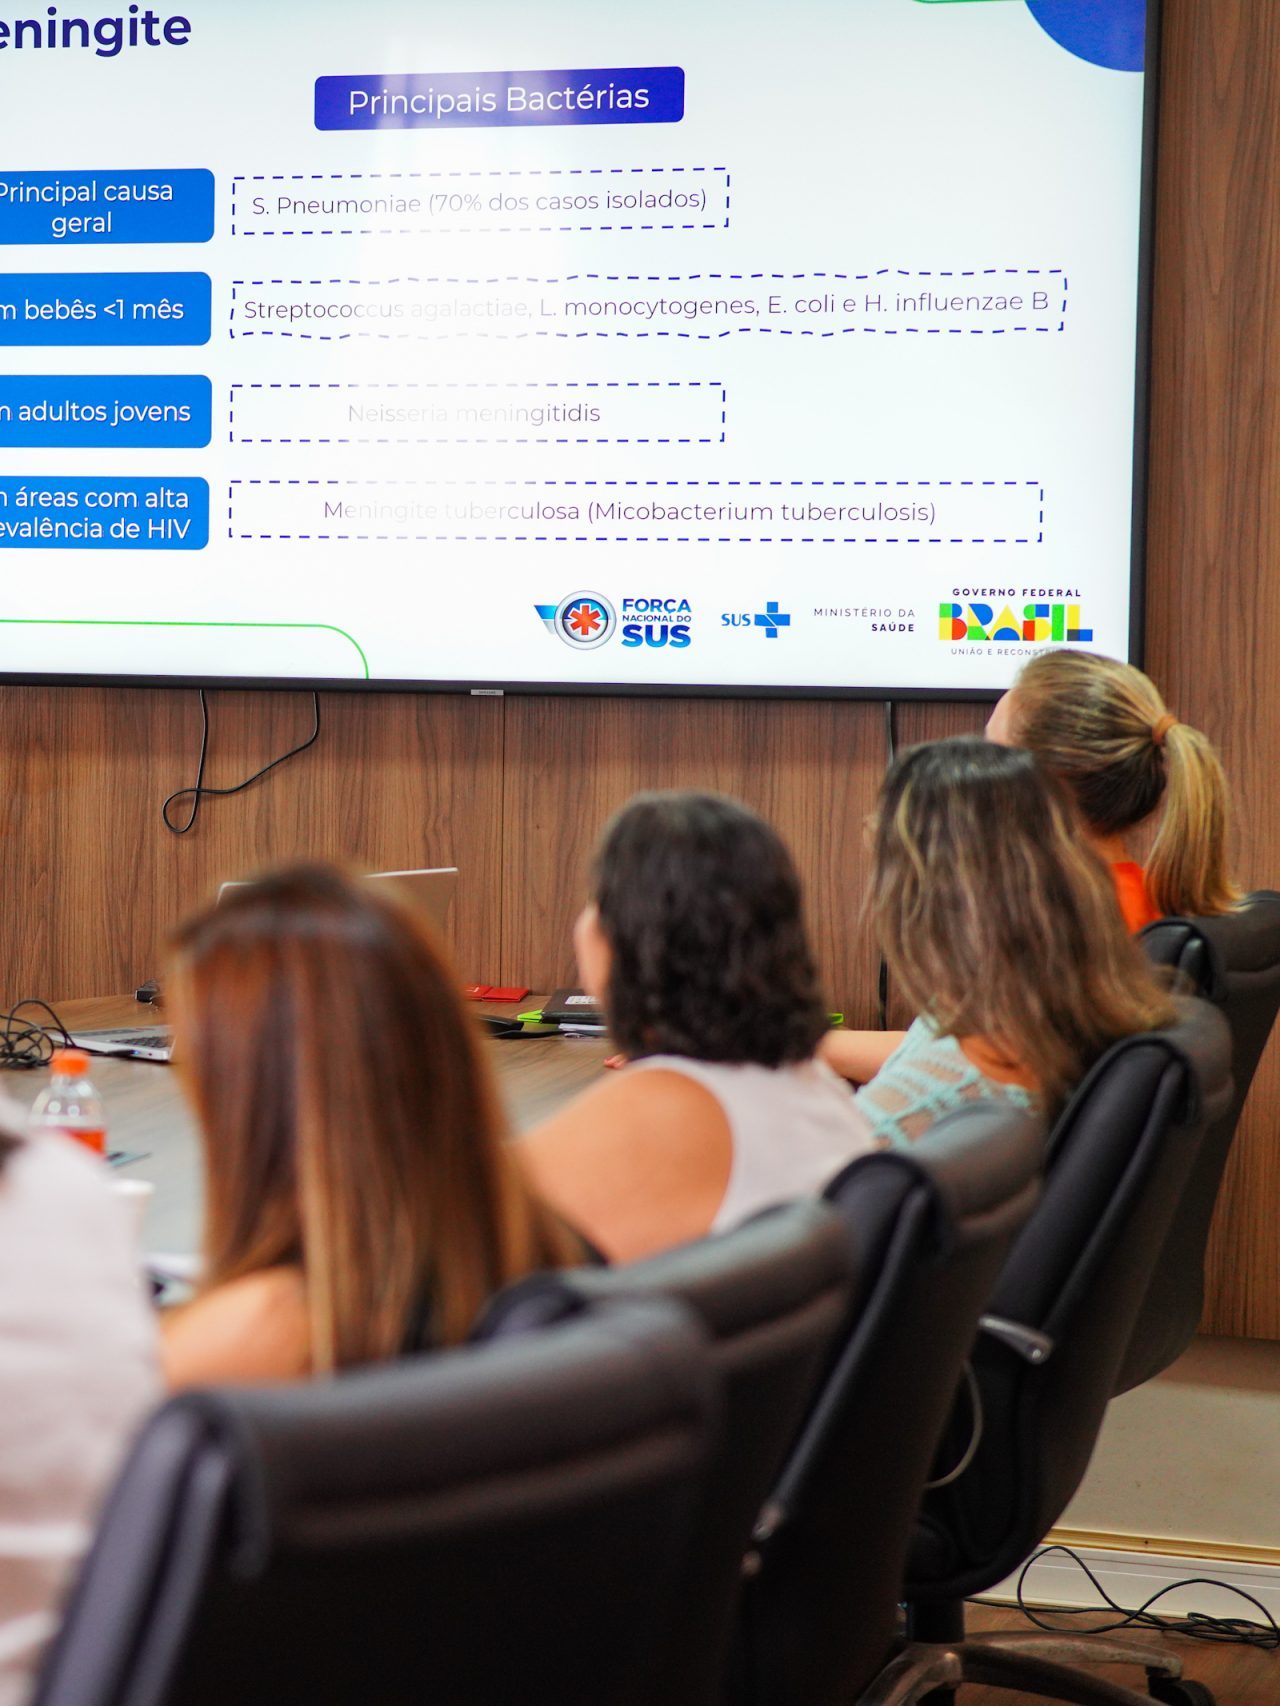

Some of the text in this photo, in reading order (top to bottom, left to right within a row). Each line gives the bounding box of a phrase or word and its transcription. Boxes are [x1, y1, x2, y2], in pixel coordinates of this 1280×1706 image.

[349, 82, 650, 120] Principais Bactérias
[103, 184, 173, 202] causa
[252, 188, 706, 217] S. Pneumoniae (70% dos casos isolados)
[51, 212, 113, 238] geral
[24, 298, 97, 321] bebês
[132, 297, 184, 320] mês
[243, 300, 406, 325] Streptococcus
[539, 301, 558, 318] L.
[564, 298, 761, 321] monocytogenes,
[768, 295, 787, 314] E.
[794, 293, 835, 314] coli
[842, 298, 857, 313] e
[865, 293, 888, 313] H.
[896, 292, 1024, 312] influenzae
[1032, 291, 1049, 310] B
[18, 399, 107, 422] adultos
[113, 401, 191, 427] jovens
[348, 402, 601, 427] Neisseria meningitidis
[15, 485, 79, 508] áreas
[84, 491, 138, 508] com
[144, 487, 189, 508] alta
[324, 500, 936, 526] Meningite tuberculosa (Micobacterium tuberculosis)
[109, 518, 140, 539] de
[148, 518, 192, 539] HIV
[952, 587, 1081, 598] GOVERNO FEDERAL
[622, 598, 692, 614] FORÇA
[814, 606, 916, 618] MINISTÉRIO DA
[622, 614, 692, 623] NACIONAL DO
[720, 613, 752, 627] SUS
[871, 621, 914, 632] SAÚDE
[938, 603, 1093, 642] BRASIL
[621, 624, 692, 648] SUS
[950, 646, 1057, 656] UNIÃO E RECONST
